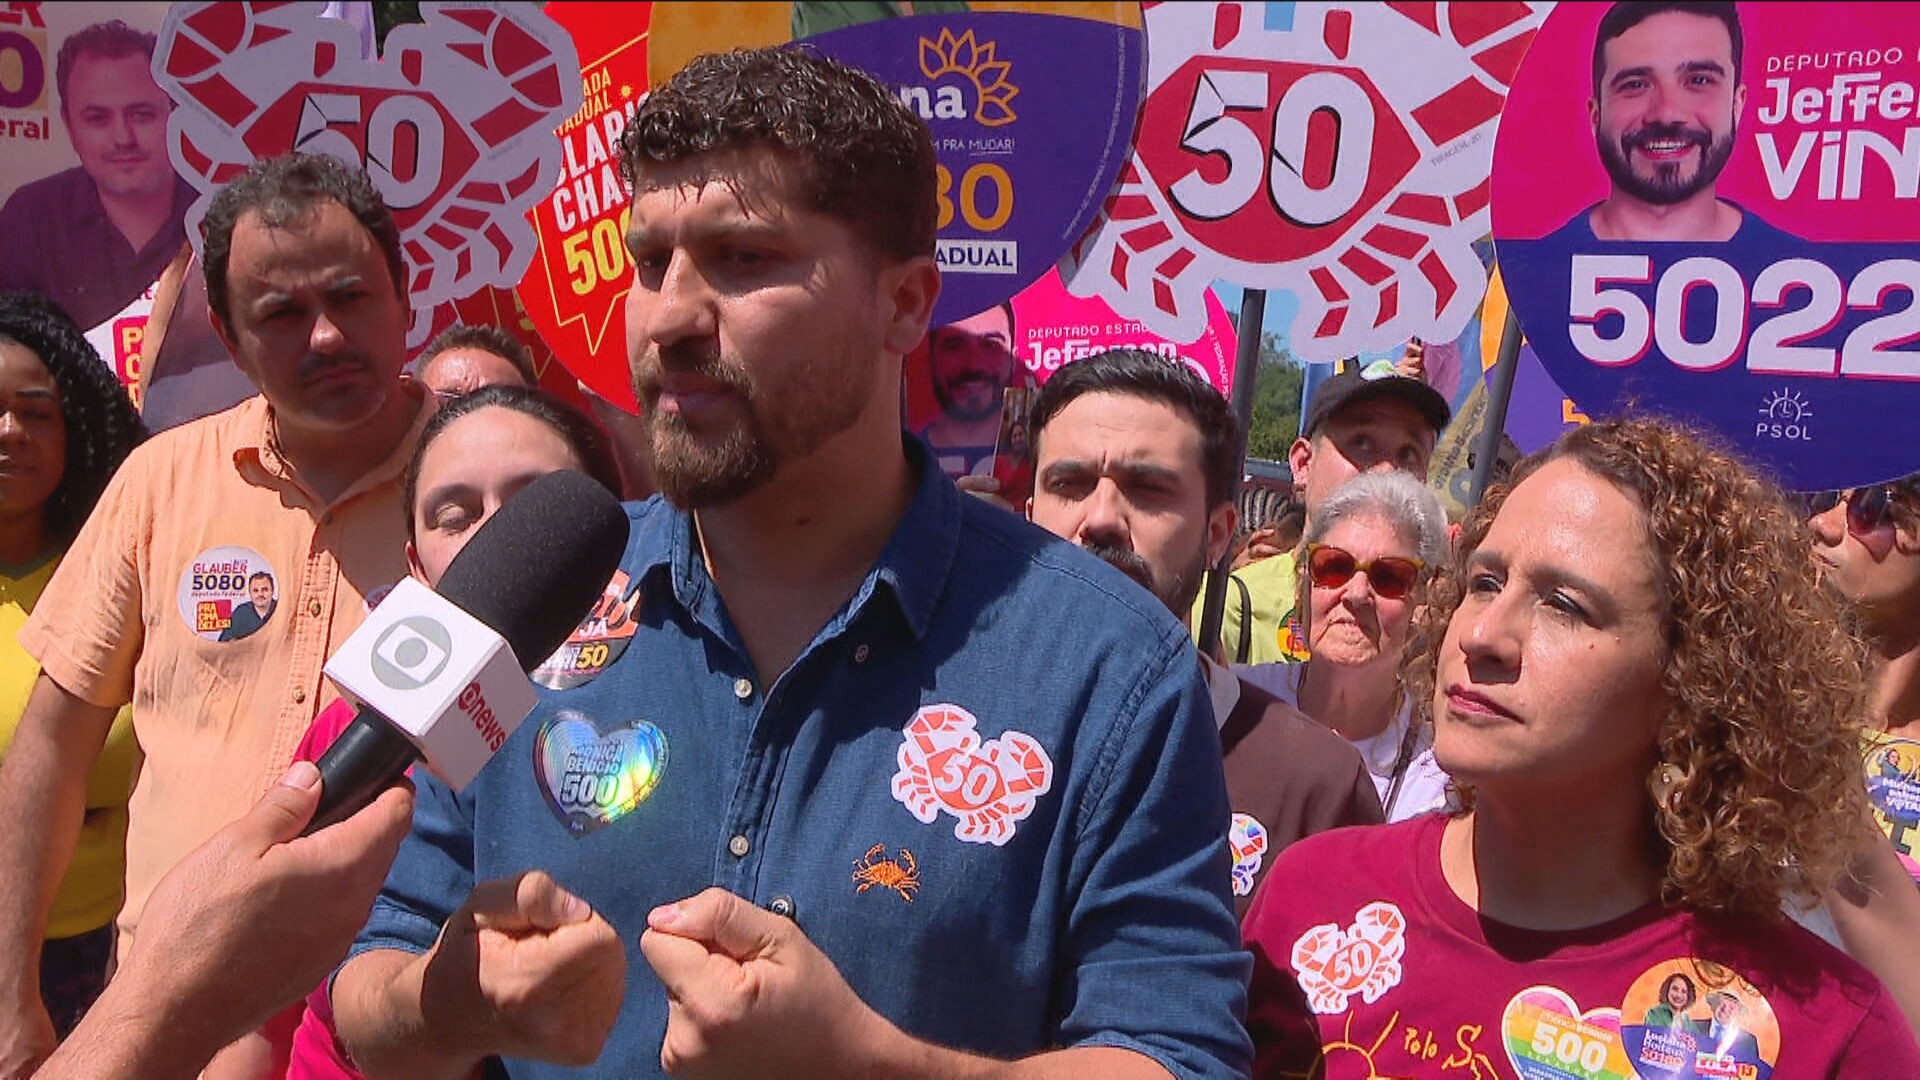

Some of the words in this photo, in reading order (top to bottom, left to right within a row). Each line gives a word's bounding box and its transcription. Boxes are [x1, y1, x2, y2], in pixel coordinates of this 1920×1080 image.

[1767, 47, 1903, 72] DEPUTADO
[1757, 71, 1920, 124] Jeffe
[943, 139, 966, 151] PRA
[1167, 68, 1375, 228] 50
[1568, 254, 1920, 380] 5022
[1028, 325, 1099, 338] DEPUTADO
[1755, 422, 1812, 440] PSOL
[192, 575, 246, 590] 5080
[193, 563, 247, 574] GLAUBER
[576, 644, 608, 669] 50
[561, 774, 618, 806] 500
[933, 753, 998, 805] 50
[1333, 942, 1373, 986] 50
[1531, 1020, 1608, 1073] 500
